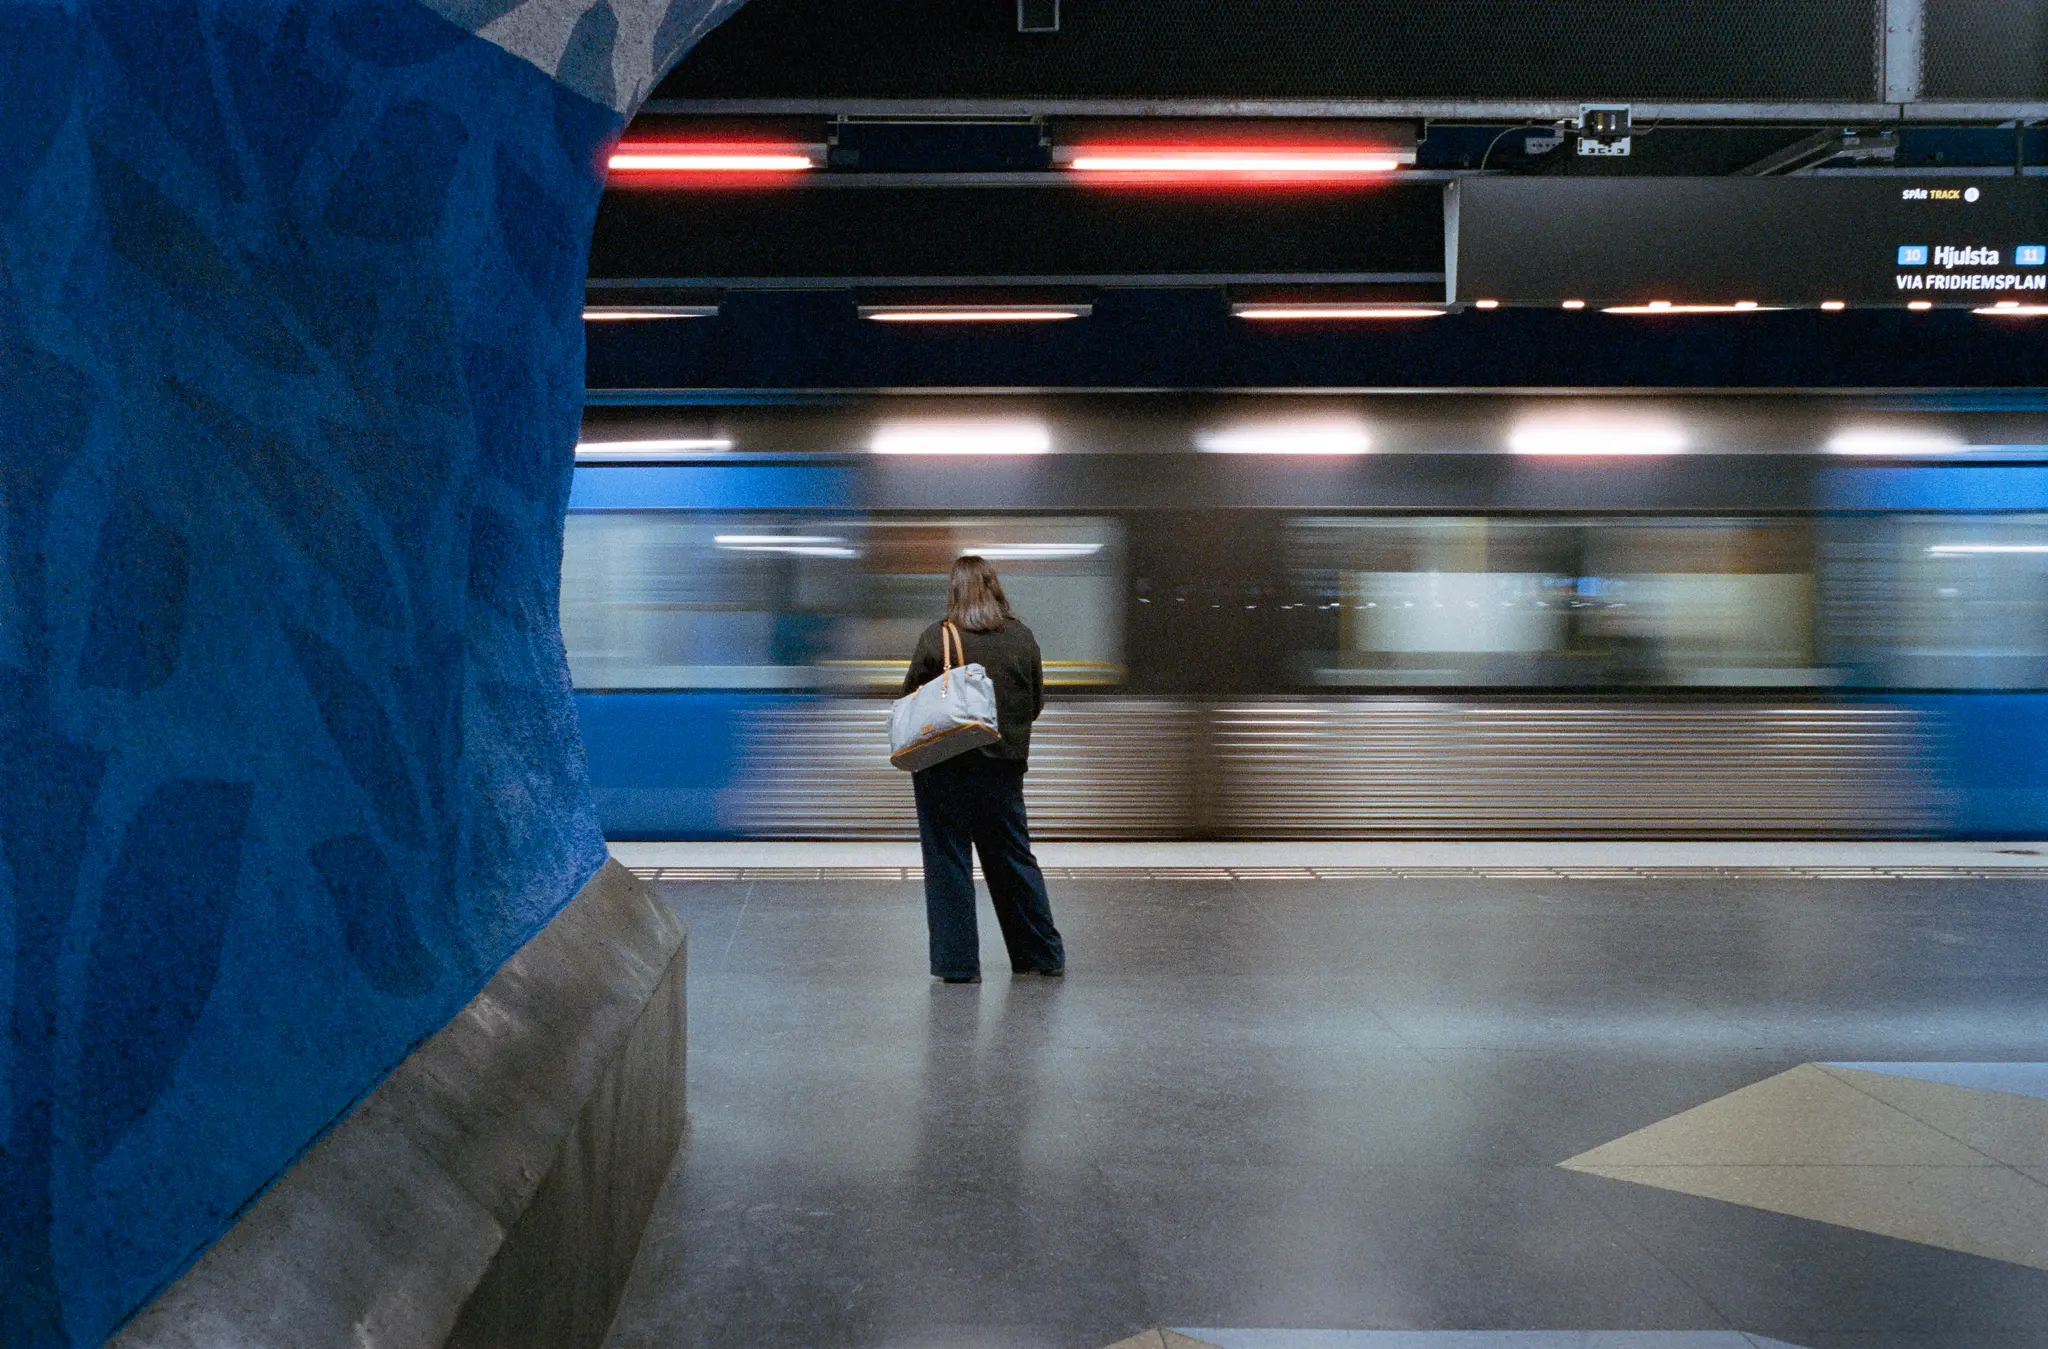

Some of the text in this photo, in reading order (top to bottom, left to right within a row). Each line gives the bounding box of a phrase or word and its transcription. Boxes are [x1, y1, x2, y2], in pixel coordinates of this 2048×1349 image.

[1902, 188, 1928, 200] SPÅR
[1930, 189, 1961, 200] TRACK
[1904, 245, 2038, 269] 10 Hjulsta 11
[1896, 275, 2047, 290] VIA FRIDHEMSPLAN
